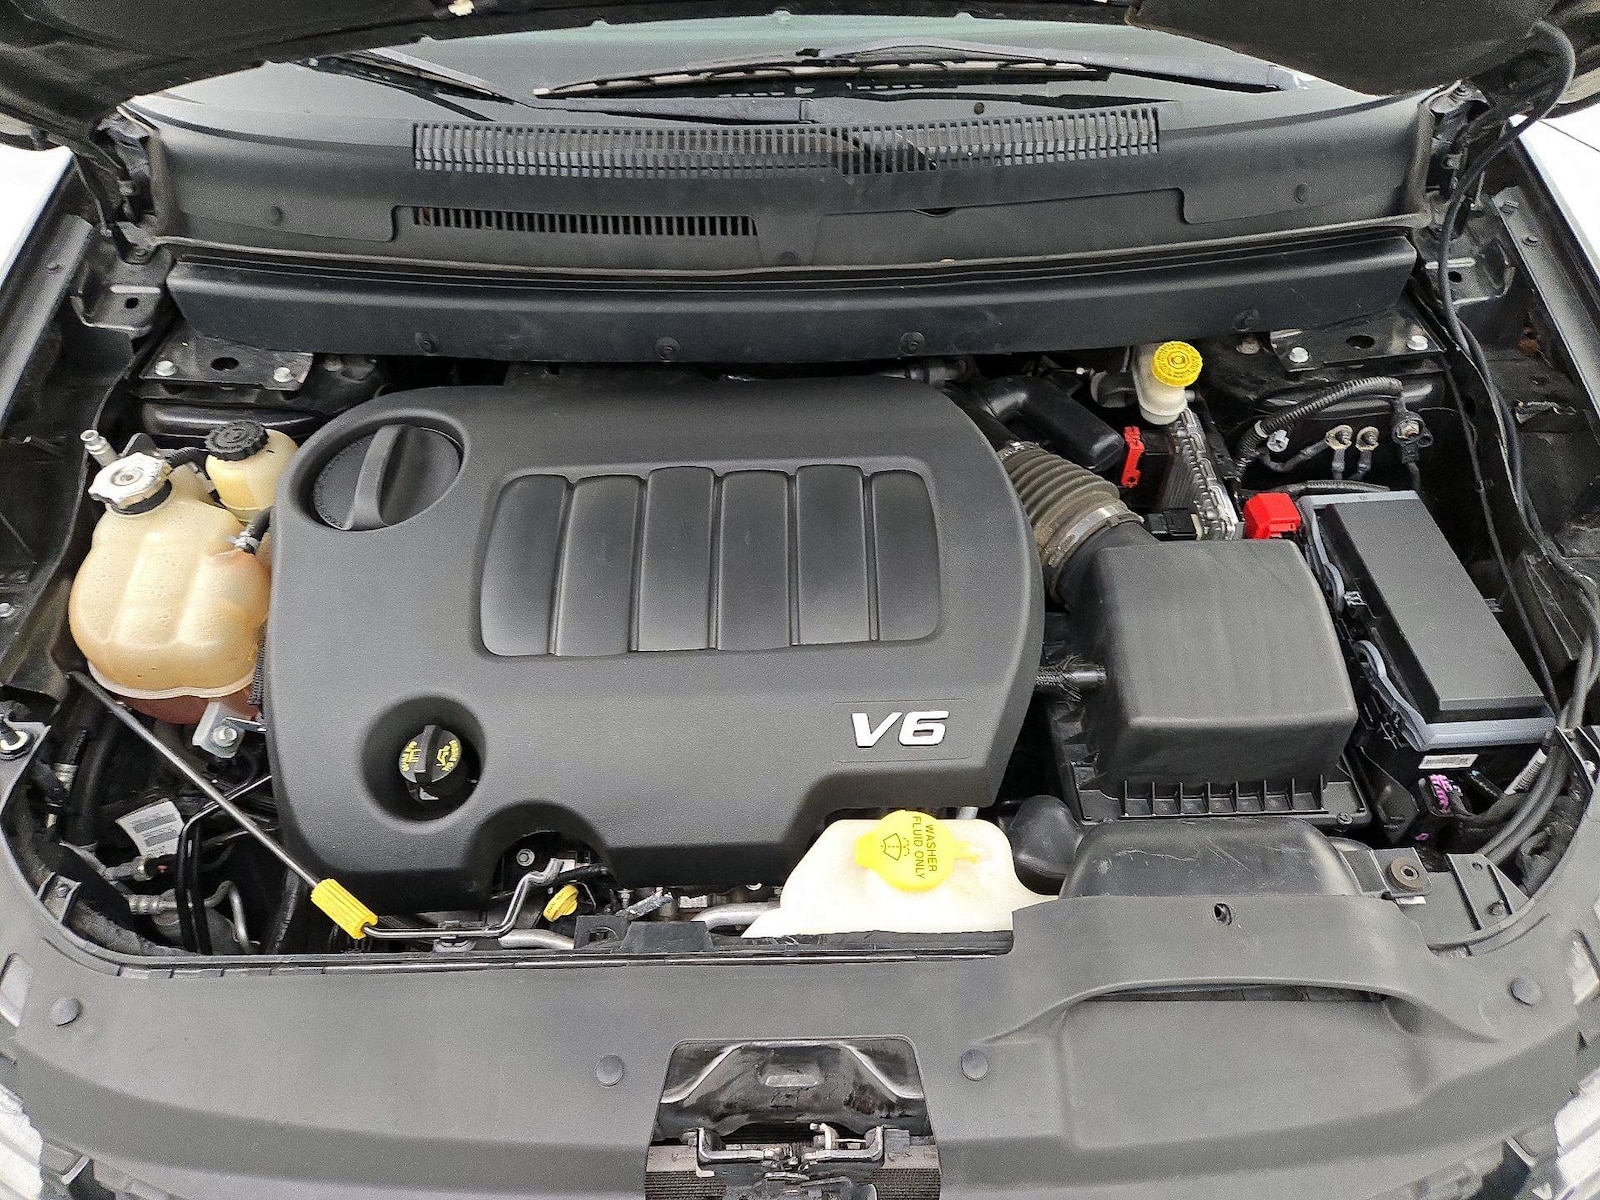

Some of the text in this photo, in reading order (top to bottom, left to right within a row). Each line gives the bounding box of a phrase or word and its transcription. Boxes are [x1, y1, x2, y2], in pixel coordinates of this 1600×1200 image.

[851, 710, 950, 748] V6
[912, 815, 926, 879] FLUID ONLY
[925, 824, 938, 872] WASHER
